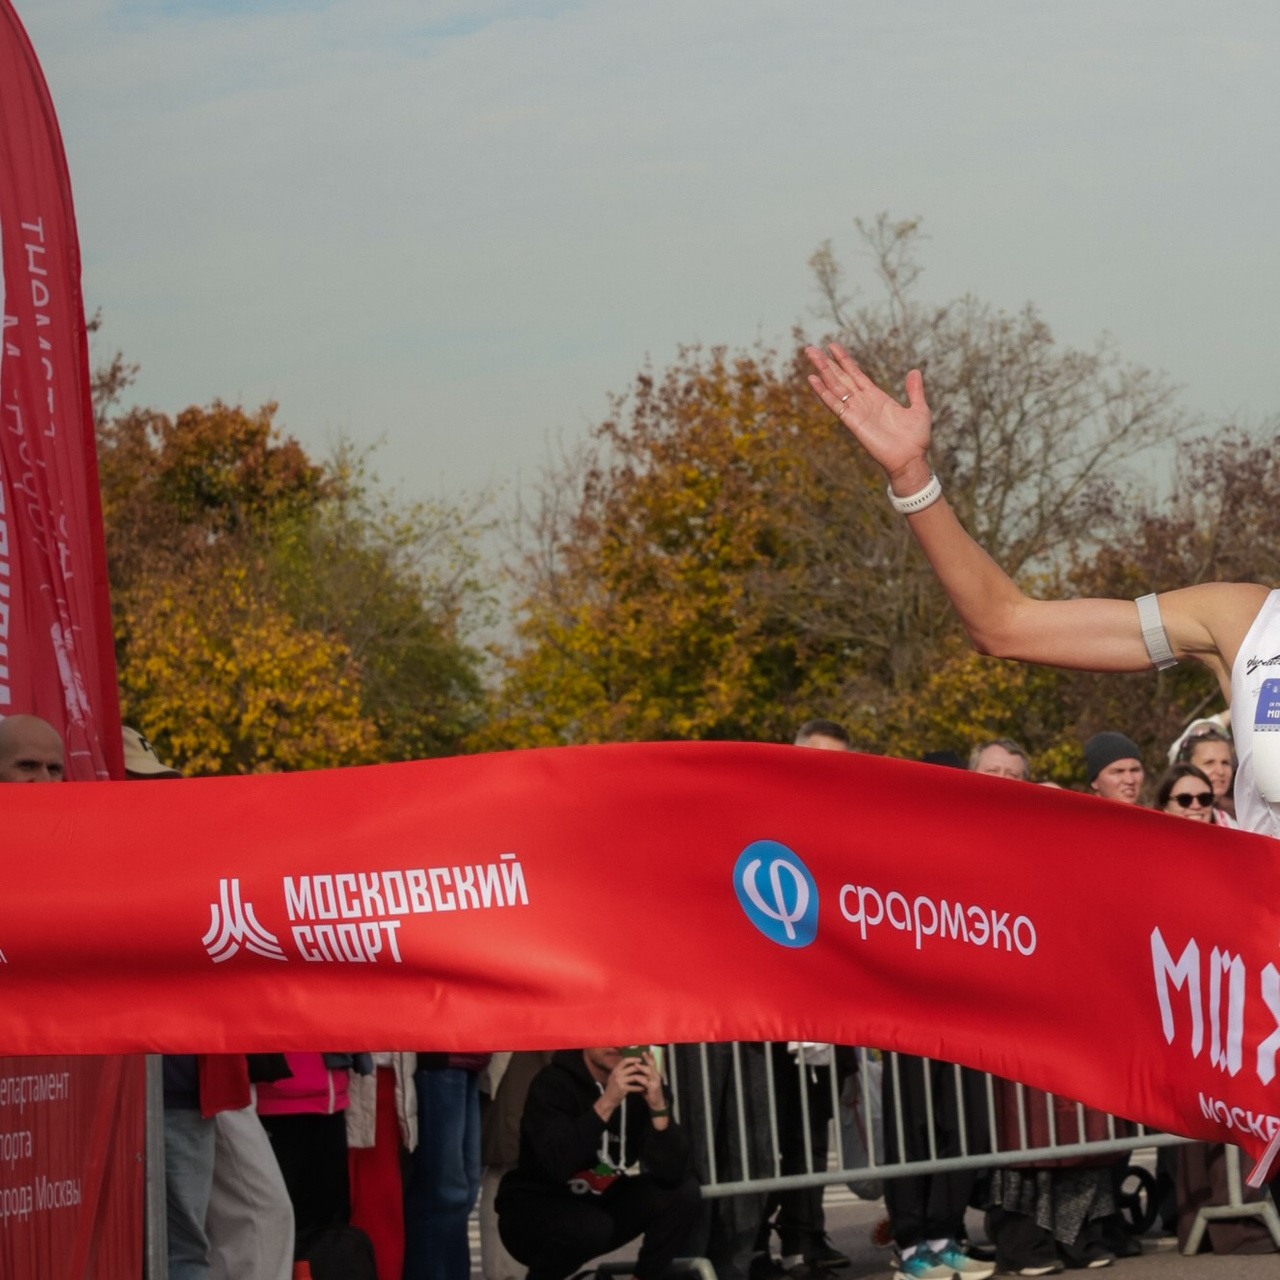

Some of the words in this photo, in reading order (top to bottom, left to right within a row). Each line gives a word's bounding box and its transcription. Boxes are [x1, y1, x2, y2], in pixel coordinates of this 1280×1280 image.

[283, 852, 530, 921] МОСКОВСКИЙ
[291, 919, 403, 963] СПОРТ
[838, 882, 1037, 957] фармэко
[35, 1174, 82, 1212] Москвы
